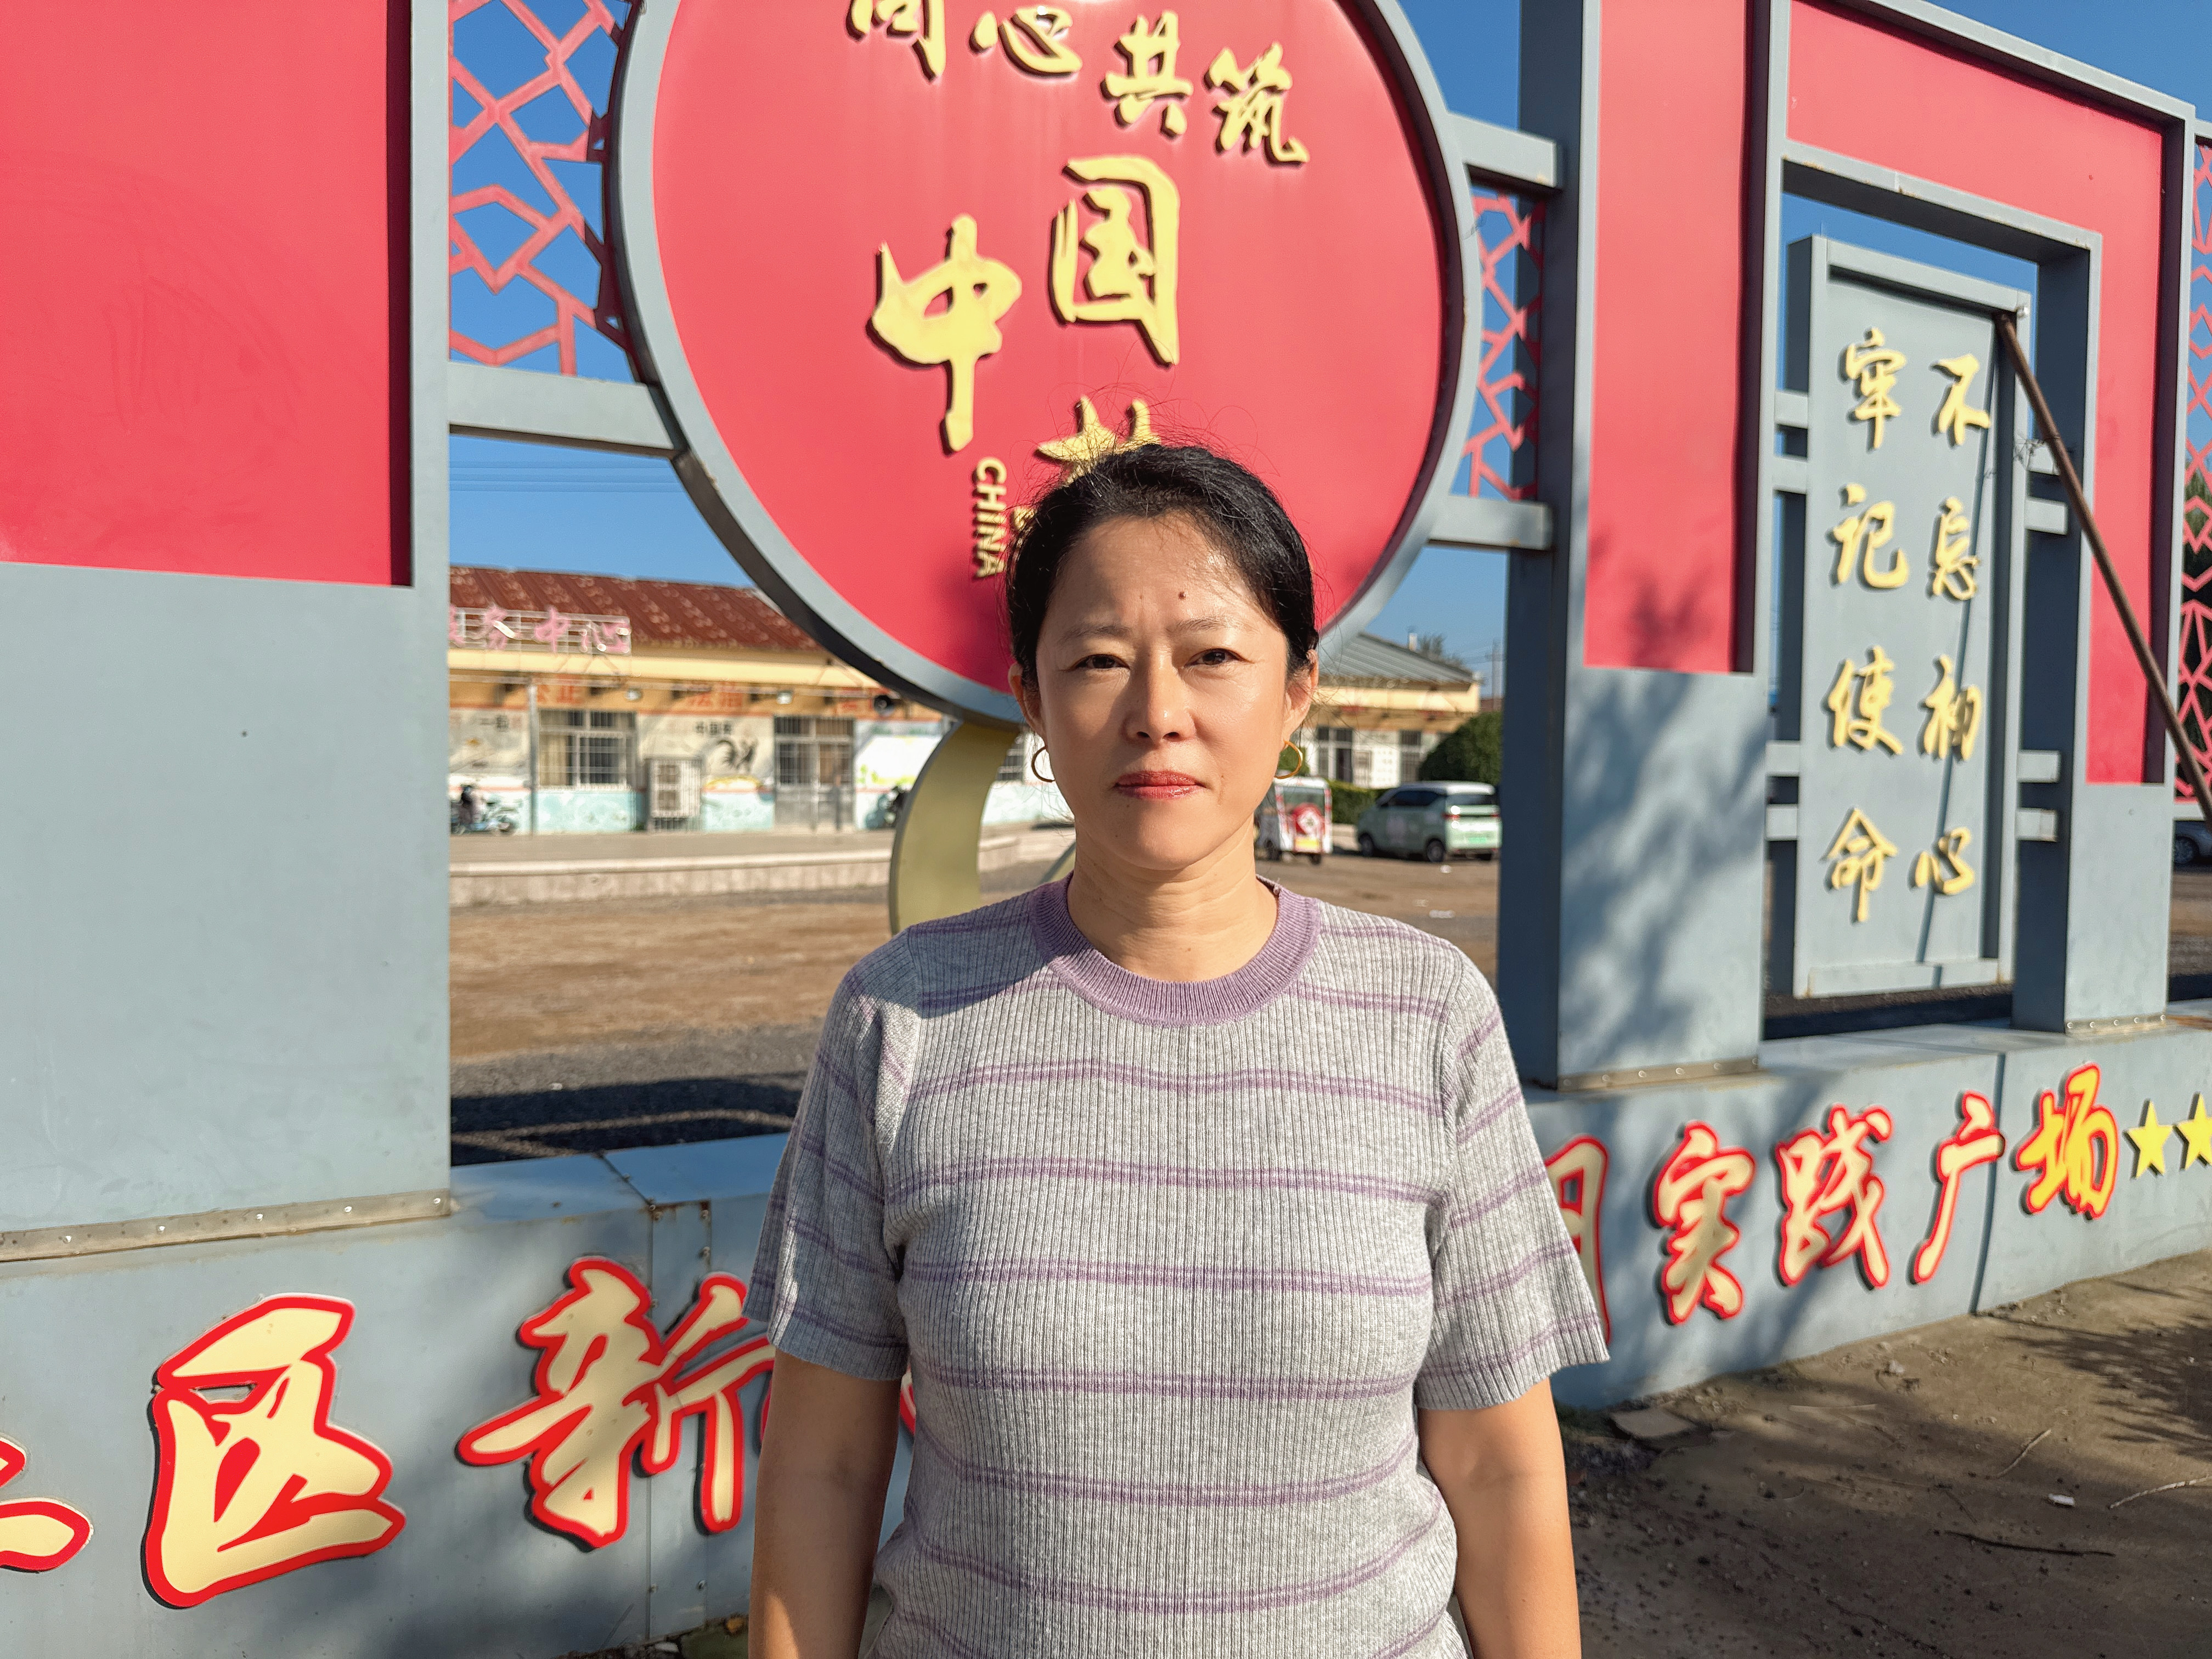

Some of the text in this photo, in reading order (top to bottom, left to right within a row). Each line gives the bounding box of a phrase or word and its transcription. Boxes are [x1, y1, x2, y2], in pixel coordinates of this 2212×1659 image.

[868, 155, 1180, 529] 中国
[974, 456, 1007, 578] CHINA
[1824, 326, 1909, 923] 牢记使命
[1910, 352, 1991, 895] 不忘初心
